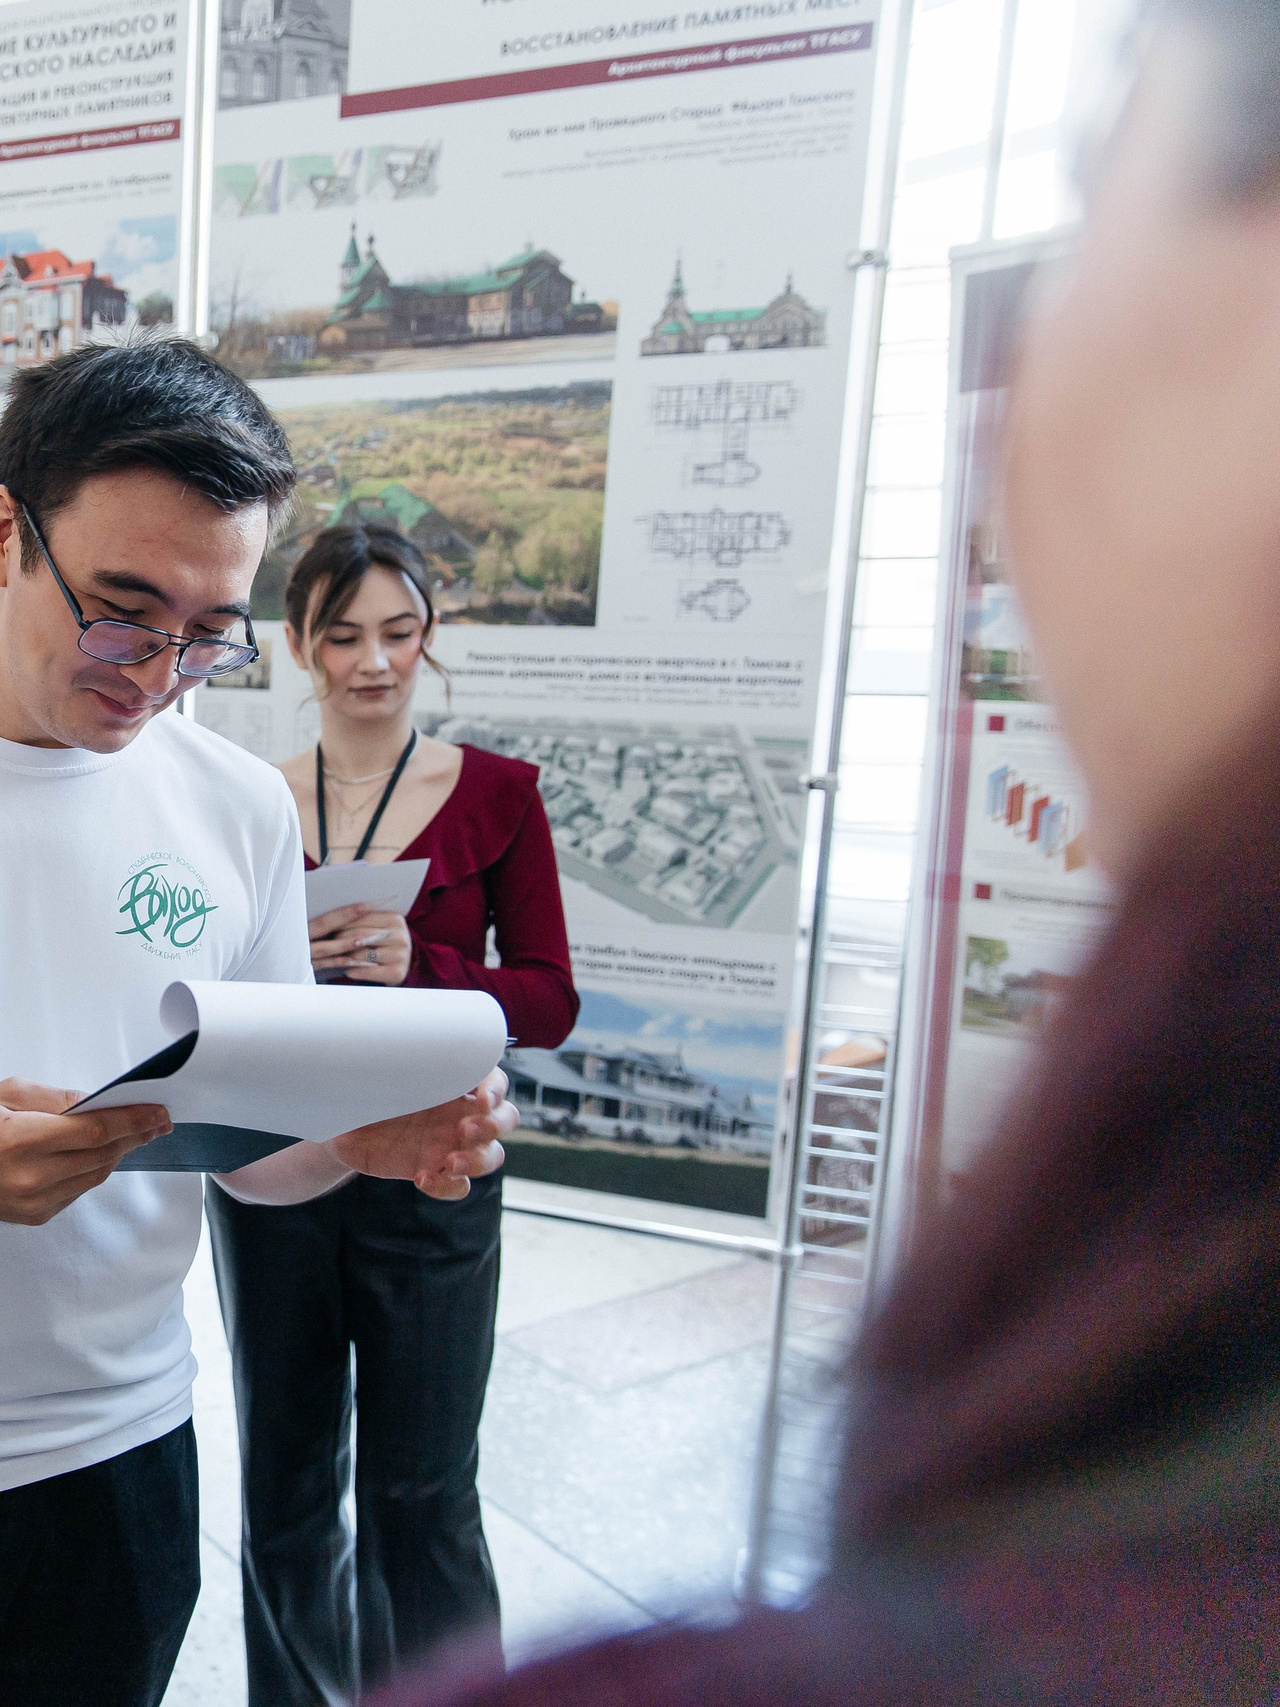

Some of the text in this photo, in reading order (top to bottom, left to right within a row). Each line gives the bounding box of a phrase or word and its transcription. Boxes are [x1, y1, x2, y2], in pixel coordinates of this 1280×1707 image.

[23, 13, 159, 51] КУЛЬТУРНОГО
[163, 11, 178, 28] И
[500, 15, 679, 57] ВОССТАНОВЛЕНИЕ
[684, 0, 800, 30] ПАМЯТНЫХ
[809, 28, 864, 50] ТГАСУ
[69, 37, 178, 69] НАСЛЕДИЯ
[53, 69, 174, 99] РЕКОНСТРУКЦИЯ
[74, 91, 173, 117] ПАМЯТНИКОВ
[141, 942, 181, 960] ДВИЖЕНИЕ
